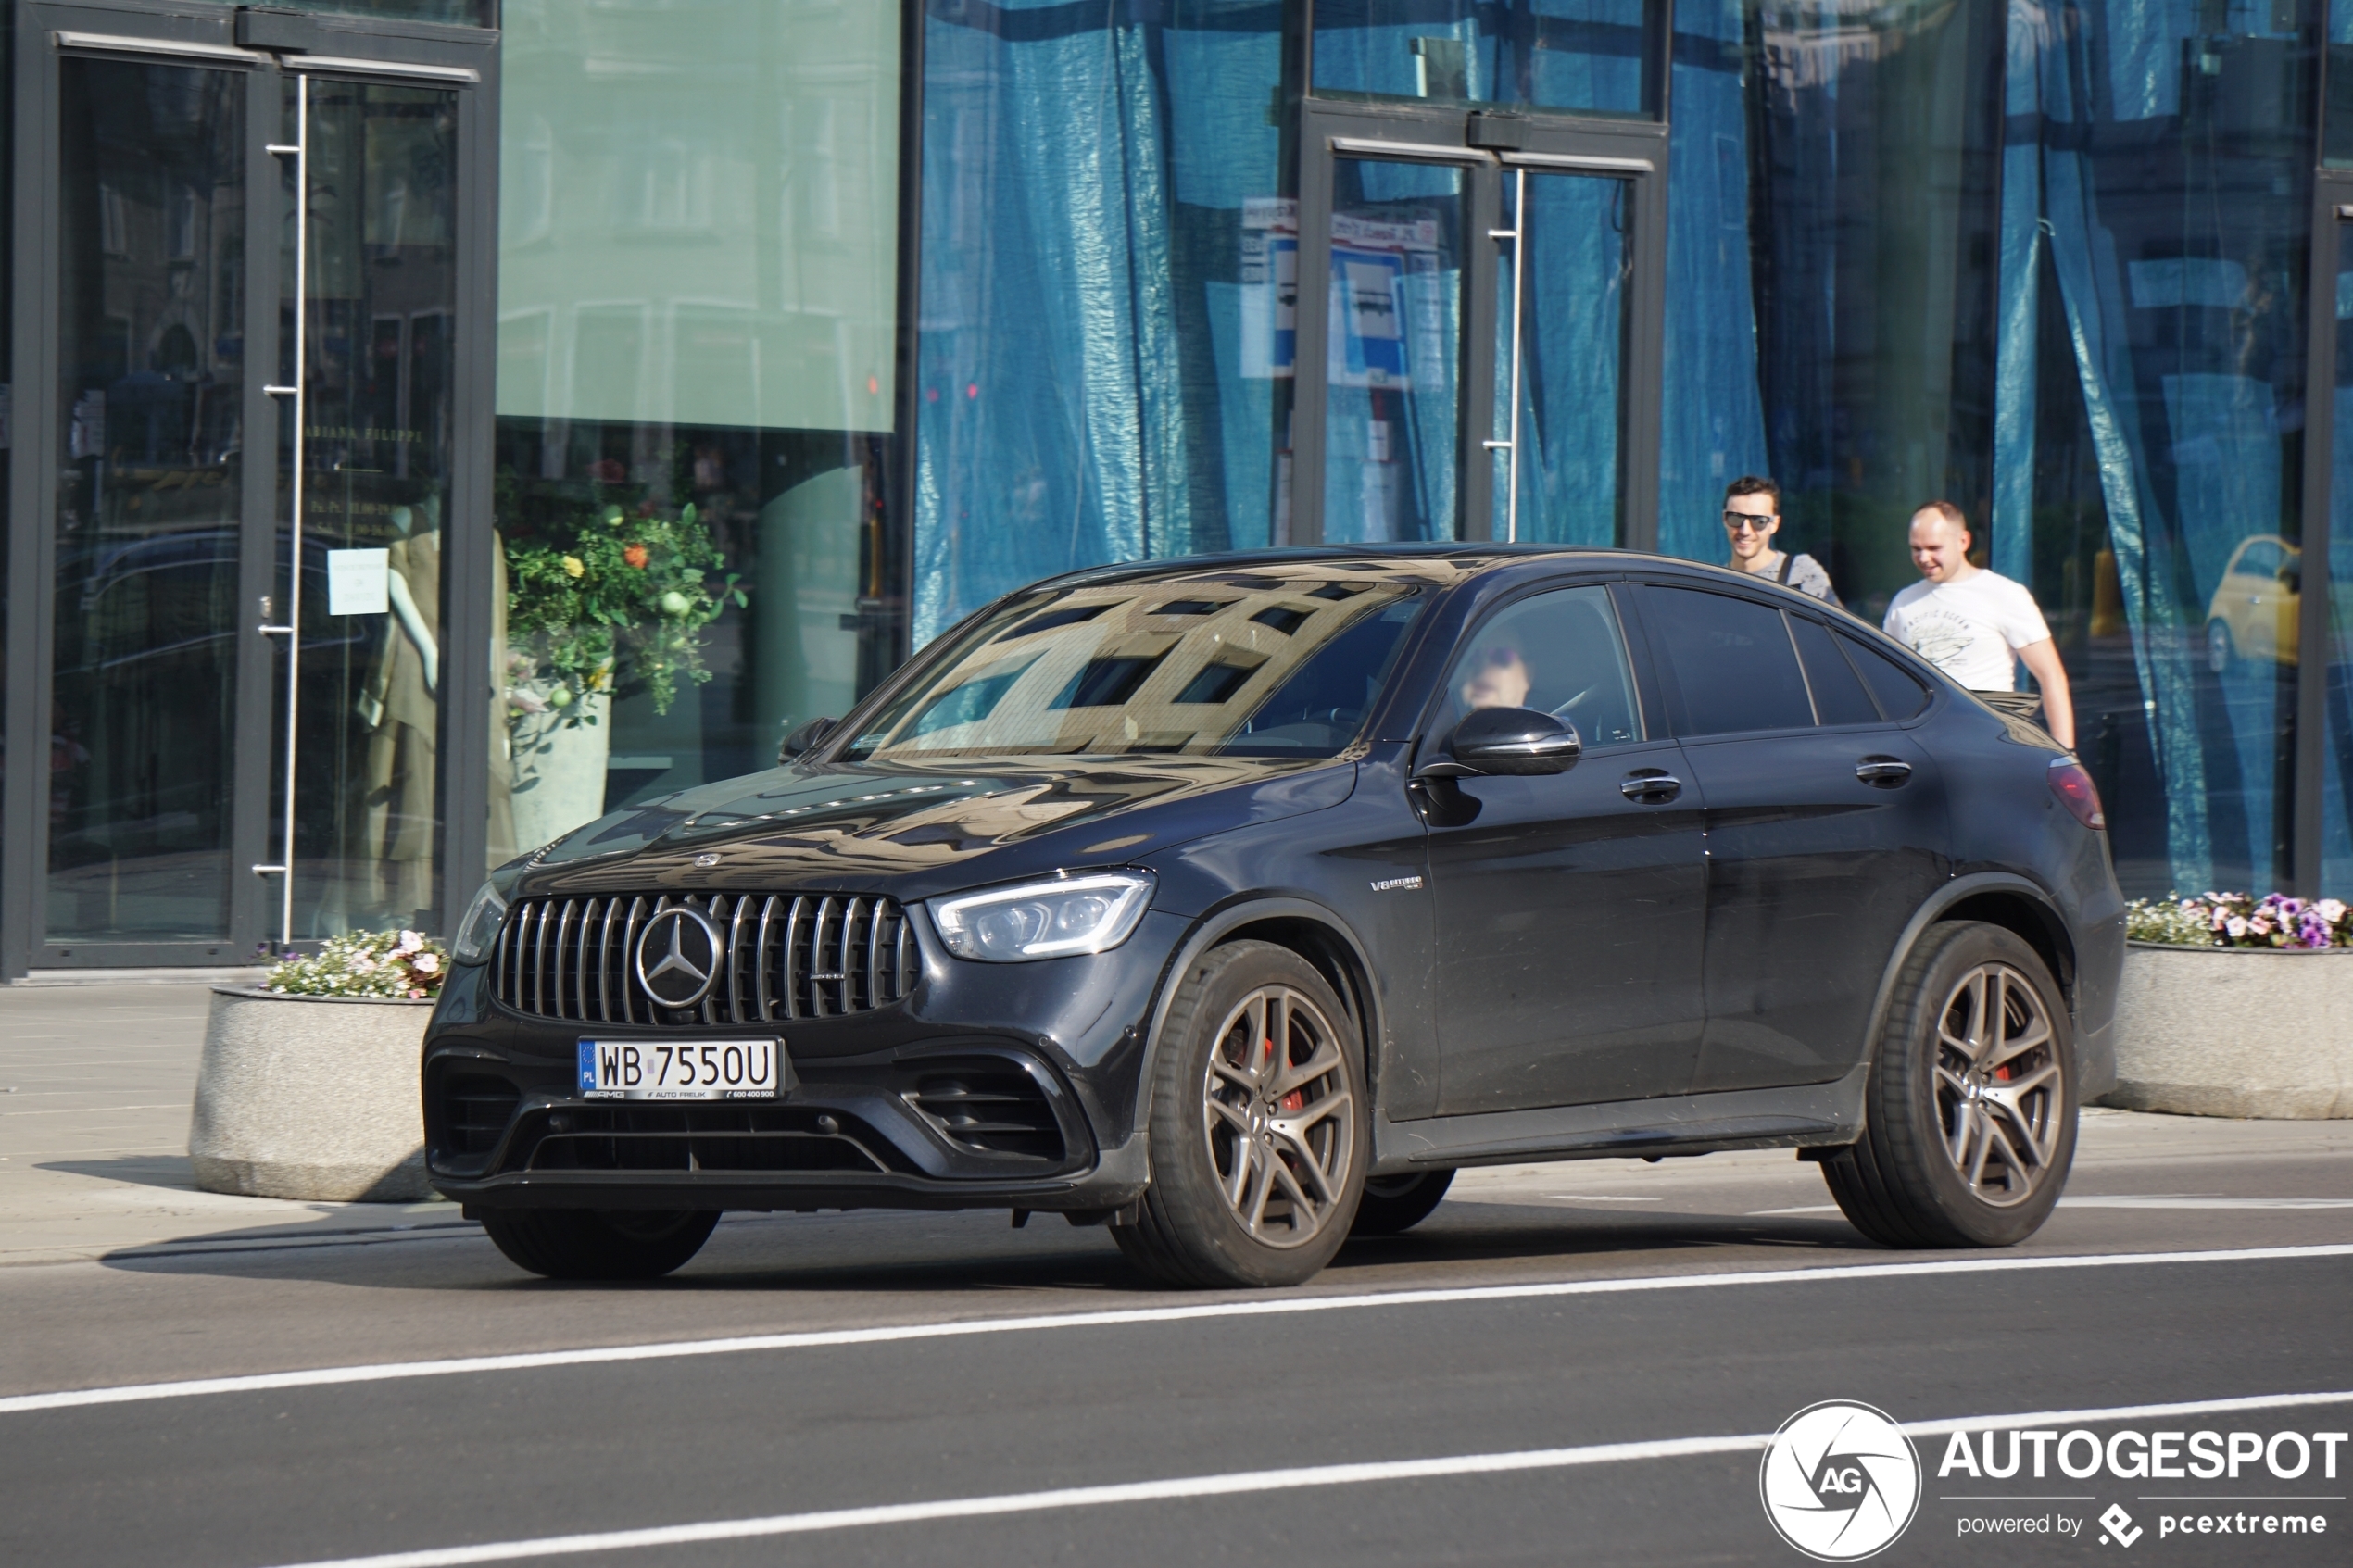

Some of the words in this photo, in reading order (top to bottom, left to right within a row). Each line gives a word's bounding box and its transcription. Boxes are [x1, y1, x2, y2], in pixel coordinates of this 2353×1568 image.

[305, 426, 357, 440] ABIANA
[1370, 880, 1390, 892] V8
[601, 1046, 643, 1086] WB
[655, 1046, 769, 1086] 7550U
[583, 1072, 595, 1083] PL
[596, 1090, 625, 1098] AMG
[733, 1090, 746, 1098] 600
[747, 1090, 761, 1098] 400
[761, 1090, 774, 1098] 900
